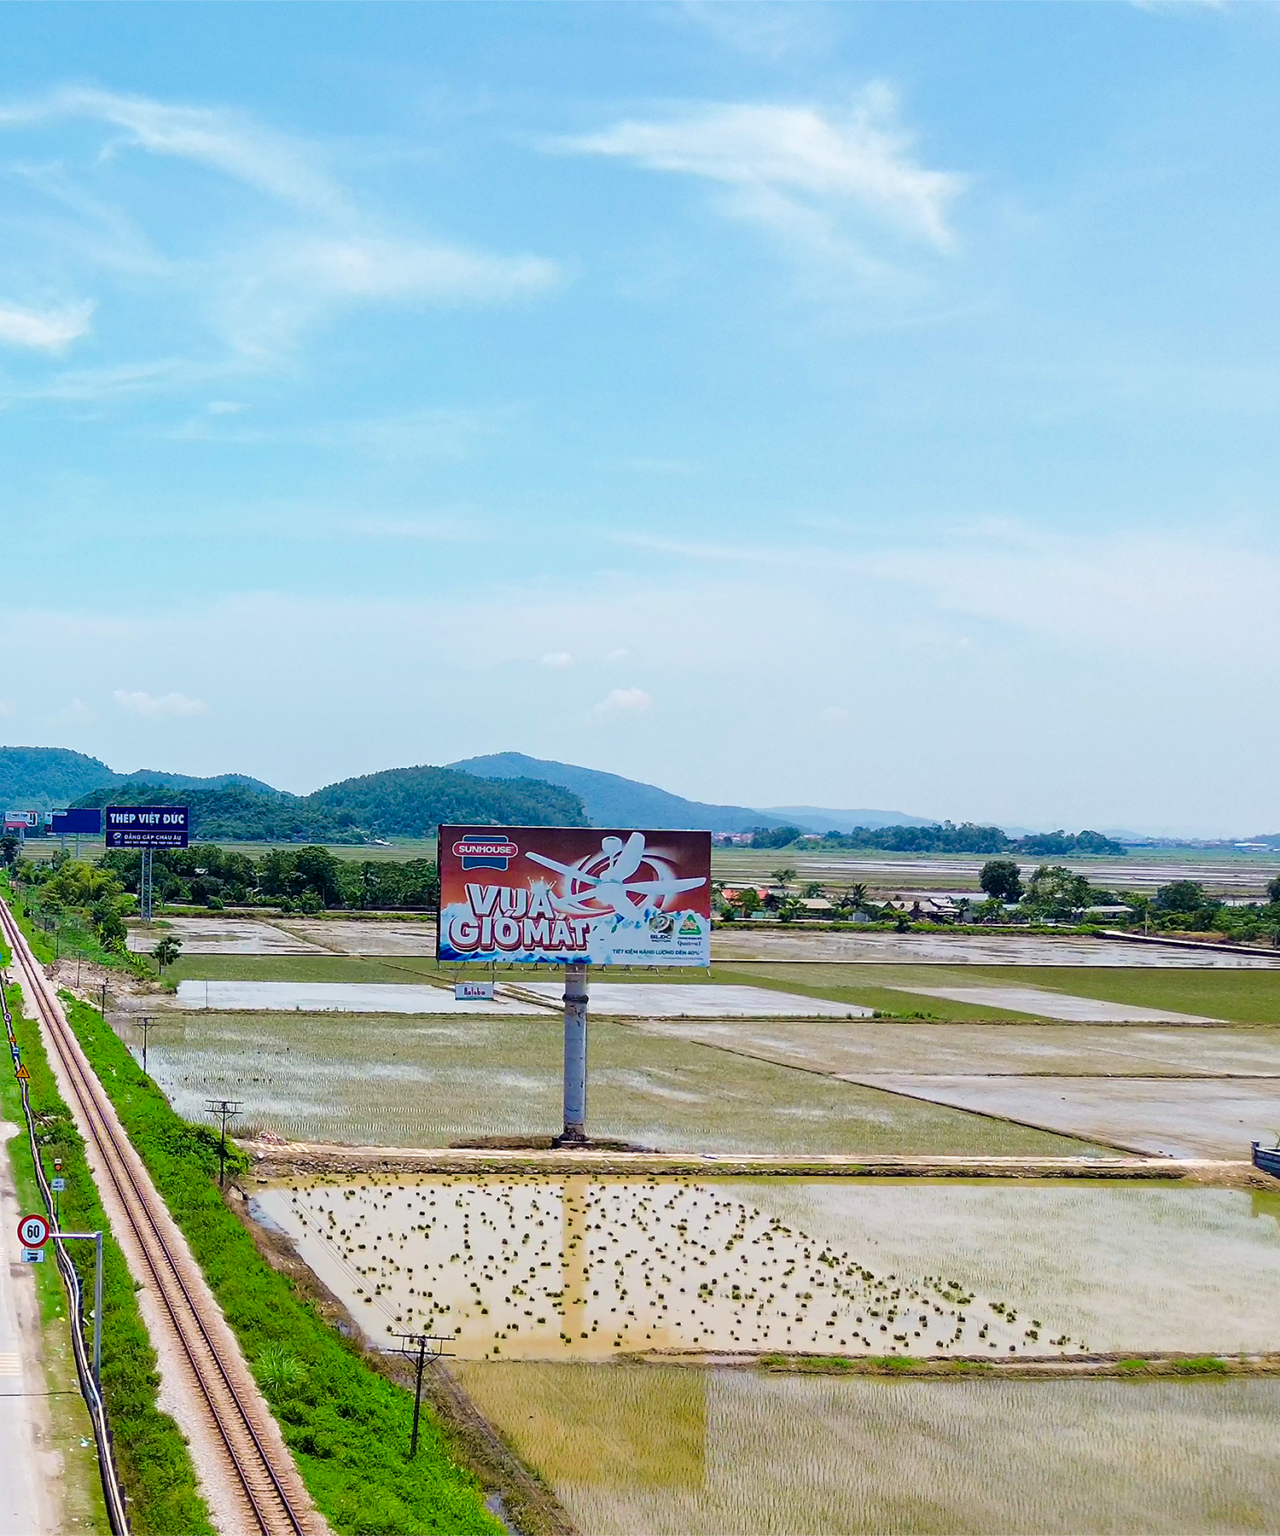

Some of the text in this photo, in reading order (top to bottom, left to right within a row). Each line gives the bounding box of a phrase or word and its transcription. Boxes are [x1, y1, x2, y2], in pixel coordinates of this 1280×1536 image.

[110, 811, 136, 823] THÉP
[138, 812, 160, 826] VIỆT
[458, 845, 512, 854] SUNHOUSE
[465, 883, 555, 920] VUA
[449, 909, 590, 951] GIÓ MÁT
[27, 1225, 40, 1238] 60
